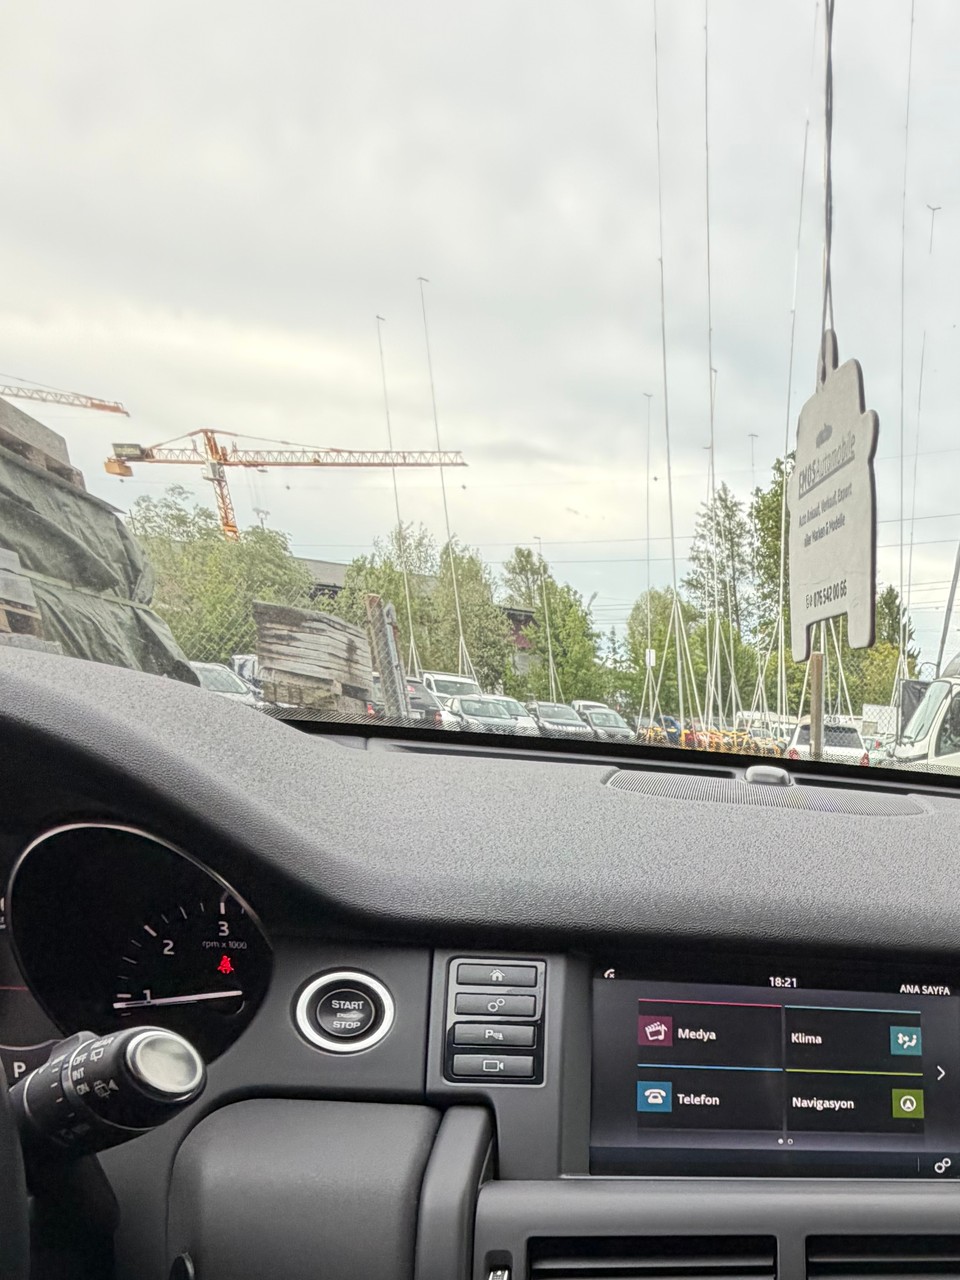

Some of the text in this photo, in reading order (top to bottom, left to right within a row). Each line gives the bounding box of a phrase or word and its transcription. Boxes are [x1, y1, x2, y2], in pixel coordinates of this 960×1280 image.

[218, 921, 229, 936] 3
[163, 940, 175, 955] 2
[202, 941, 220, 949] rpm
[228, 940, 248, 950] 1000
[768, 976, 798, 989] 18:21
[900, 983, 951, 997] ANA SAYFA
[331, 1000, 364, 1010] START
[332, 1020, 361, 1029] STOP
[677, 1028, 717, 1042] Medya
[791, 1032, 823, 1045] Klima
[73, 1053, 88, 1066] OFF
[14, 1061, 26, 1078] P
[72, 1067, 85, 1081] INT
[76, 1082, 90, 1095] ON
[677, 1093, 720, 1106] Telefon
[792, 1096, 855, 1112] Navigasyon
